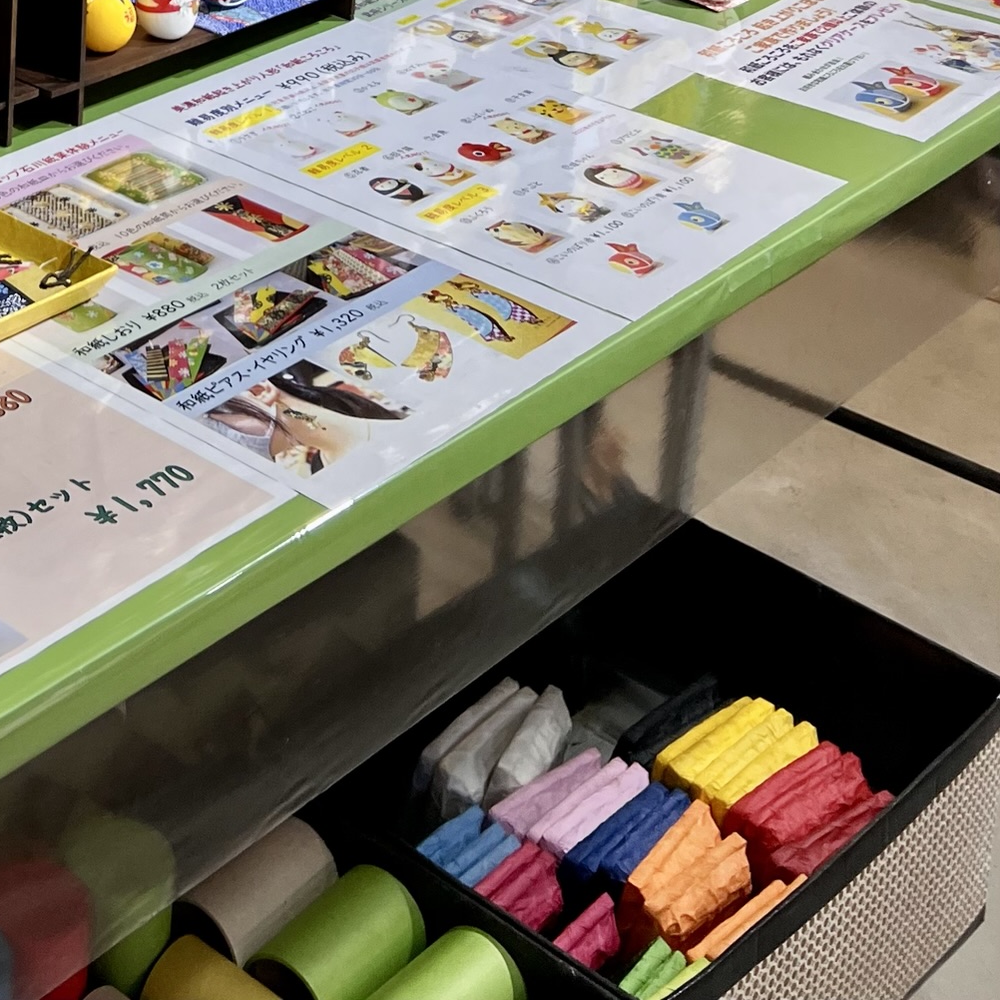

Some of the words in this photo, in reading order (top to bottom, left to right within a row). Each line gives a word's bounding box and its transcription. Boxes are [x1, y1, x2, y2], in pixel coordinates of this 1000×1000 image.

[185, 89, 272, 127] 難易度別メニュー
[307, 150, 361, 175] 難易度レベル
[423, 191, 479, 221] 難易度レベル
[72, 319, 142, 358] 和紙しおり
[142, 298, 187, 323] ¥880
[175, 334, 307, 412] 和紙ピアス・イヤリング
[308, 308, 365, 339] ¥1,320
[84, 464, 195, 527] ¥1,770
